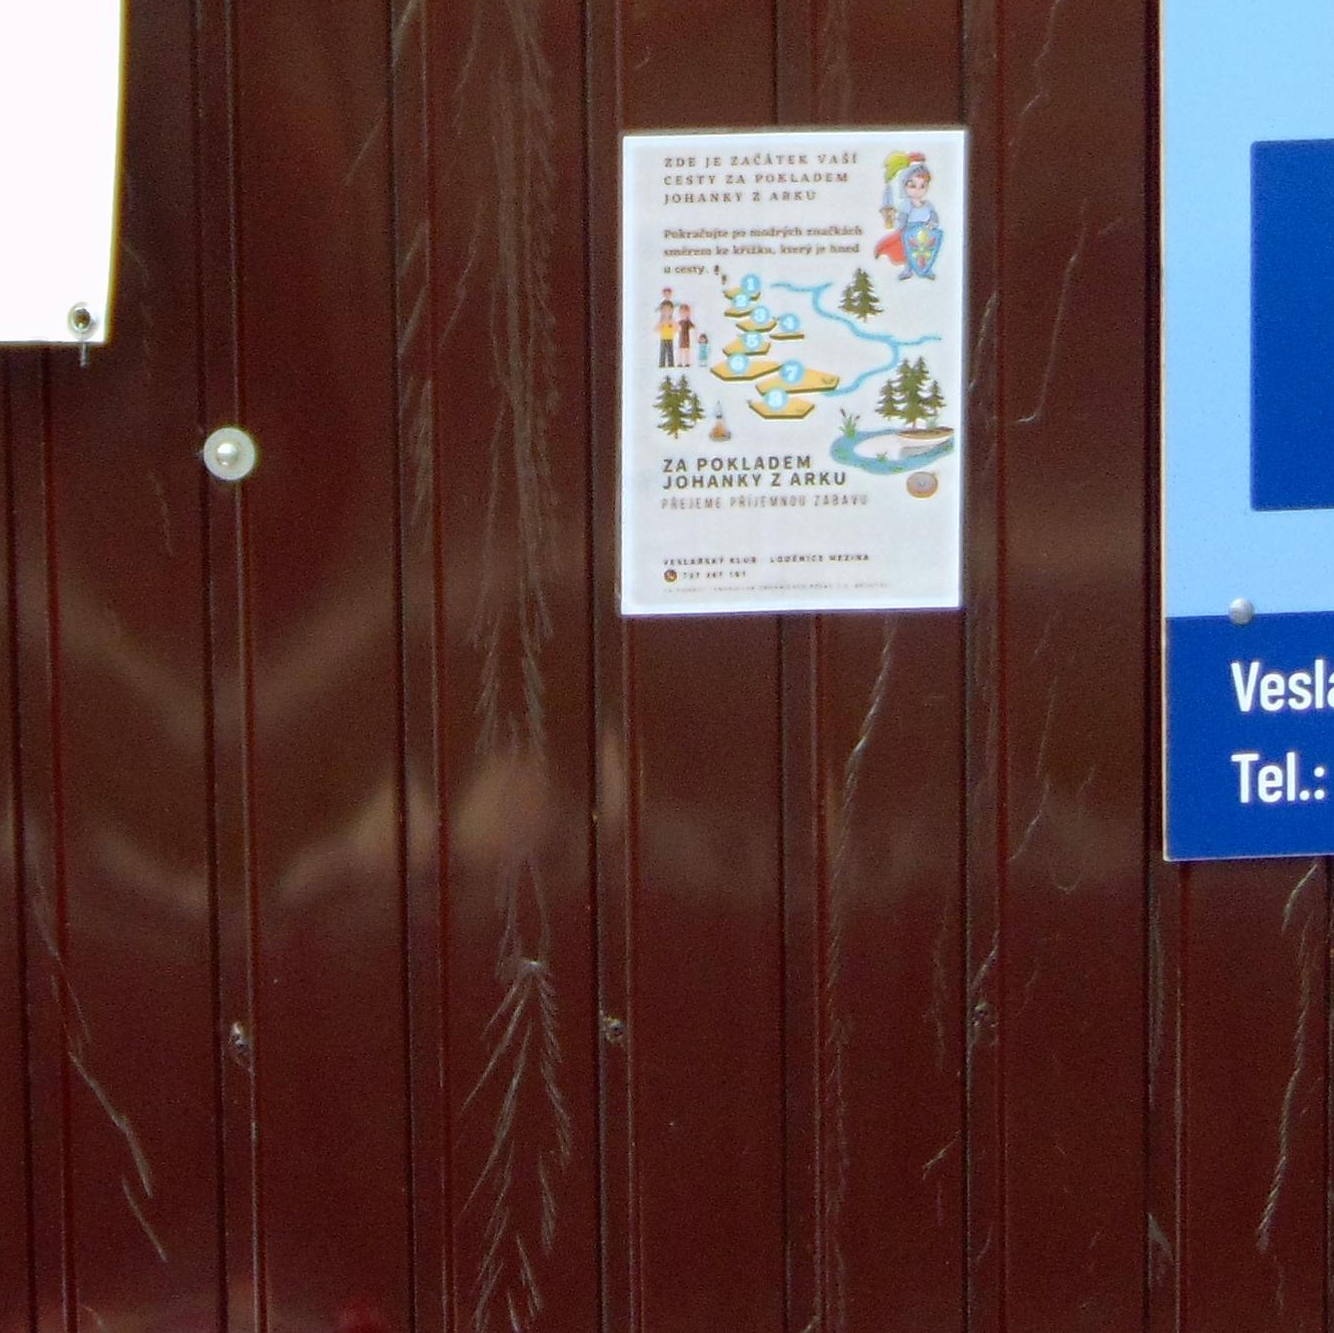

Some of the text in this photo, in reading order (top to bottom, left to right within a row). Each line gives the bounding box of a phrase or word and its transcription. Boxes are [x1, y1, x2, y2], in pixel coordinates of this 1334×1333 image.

[664, 157, 696, 168] ZDE
[705, 157, 722, 168] JE
[730, 154, 809, 167] ZAČÁTEK
[663, 172, 849, 186] CESTY ZA POKLADEM
[663, 191, 817, 206] JOHANKY Z ARKU
[663, 455, 812, 473] ZA POKLADEM
[663, 472, 846, 490] JOHANKY Z ARKU
[1231, 751, 1326, 804] Tel.:
